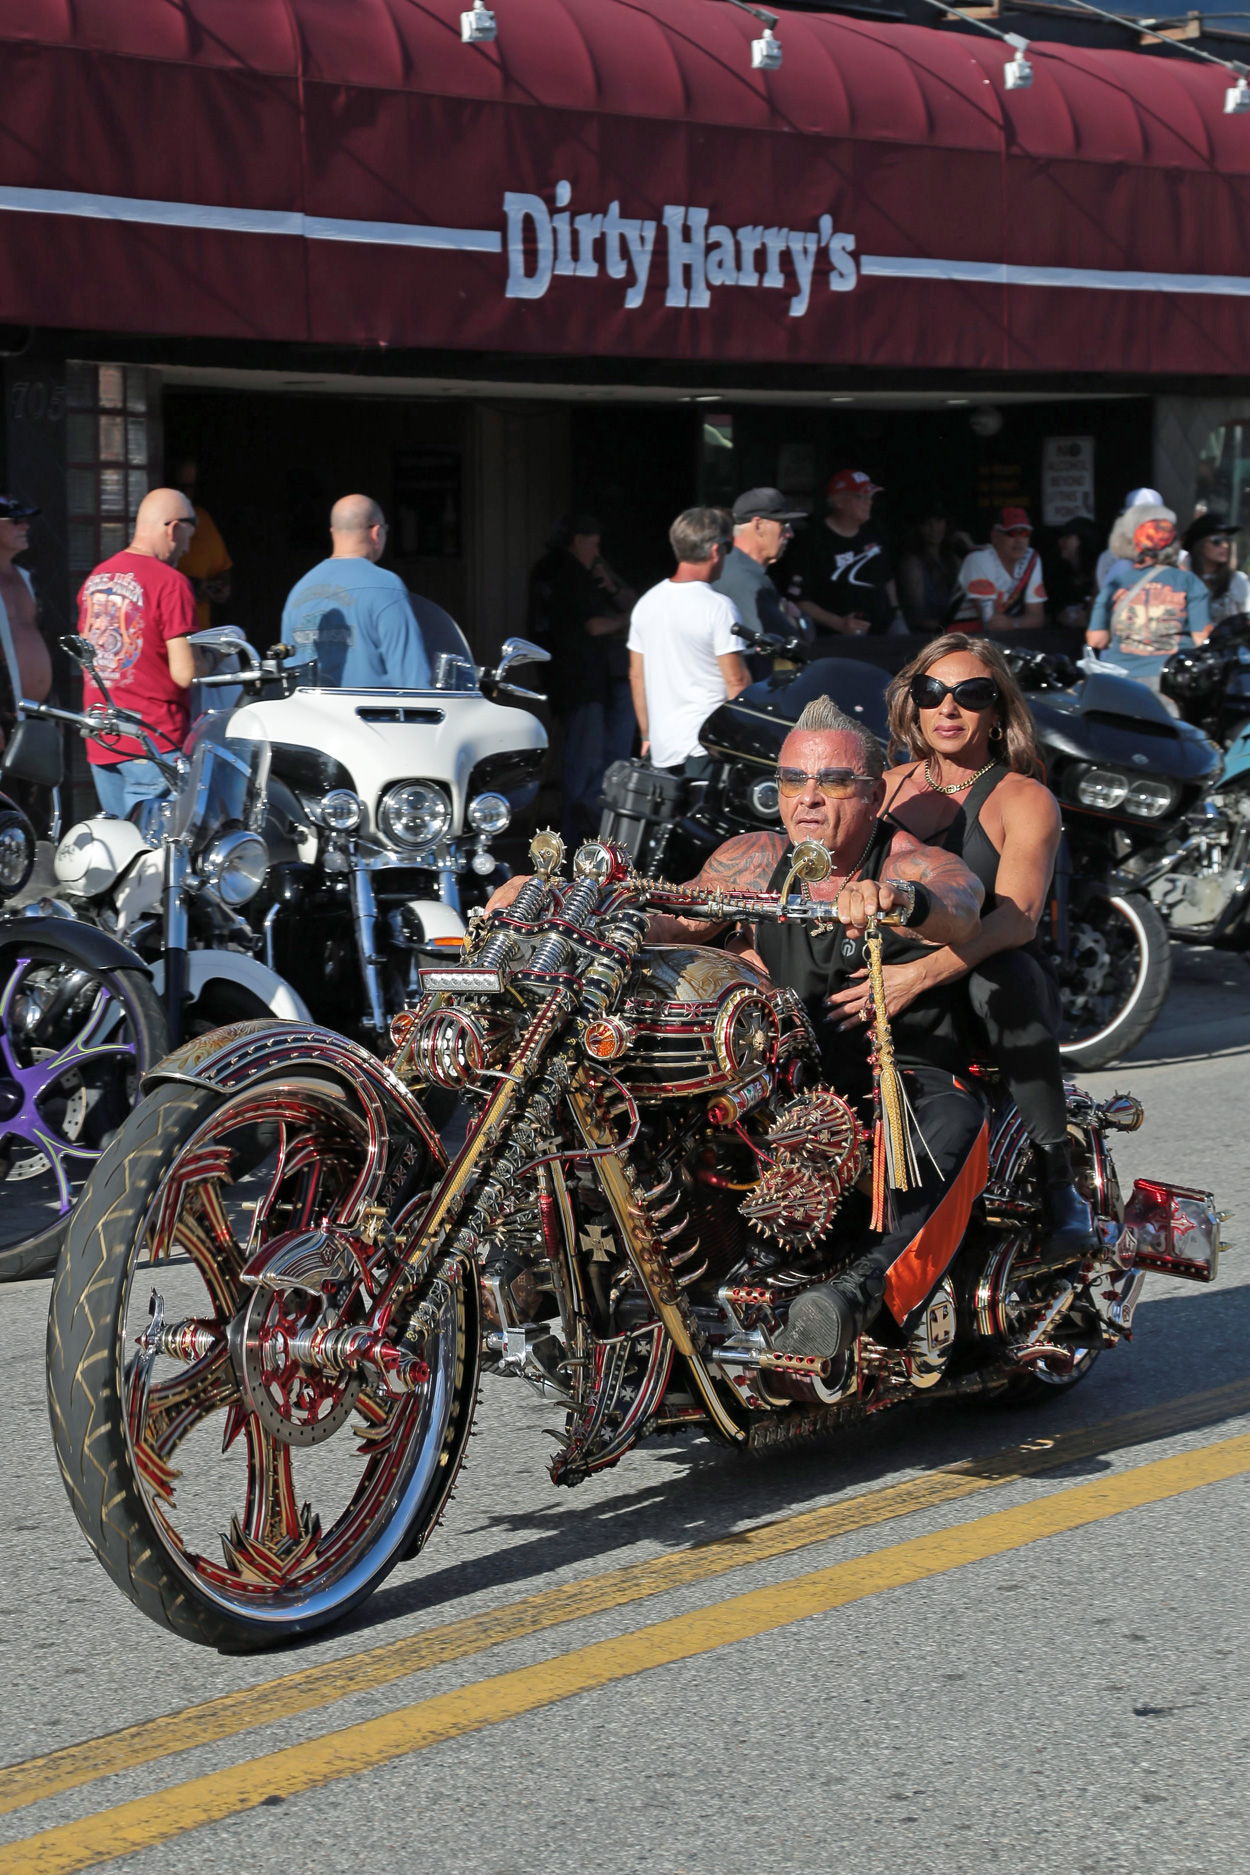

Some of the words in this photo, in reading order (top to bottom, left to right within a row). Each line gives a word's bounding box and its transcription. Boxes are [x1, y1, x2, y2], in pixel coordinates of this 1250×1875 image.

[503, 180, 657, 309] Dirty
[663, 205, 858, 317] Harry's
[11, 382, 65, 421] 705
[1056, 443, 1081, 457] NO
